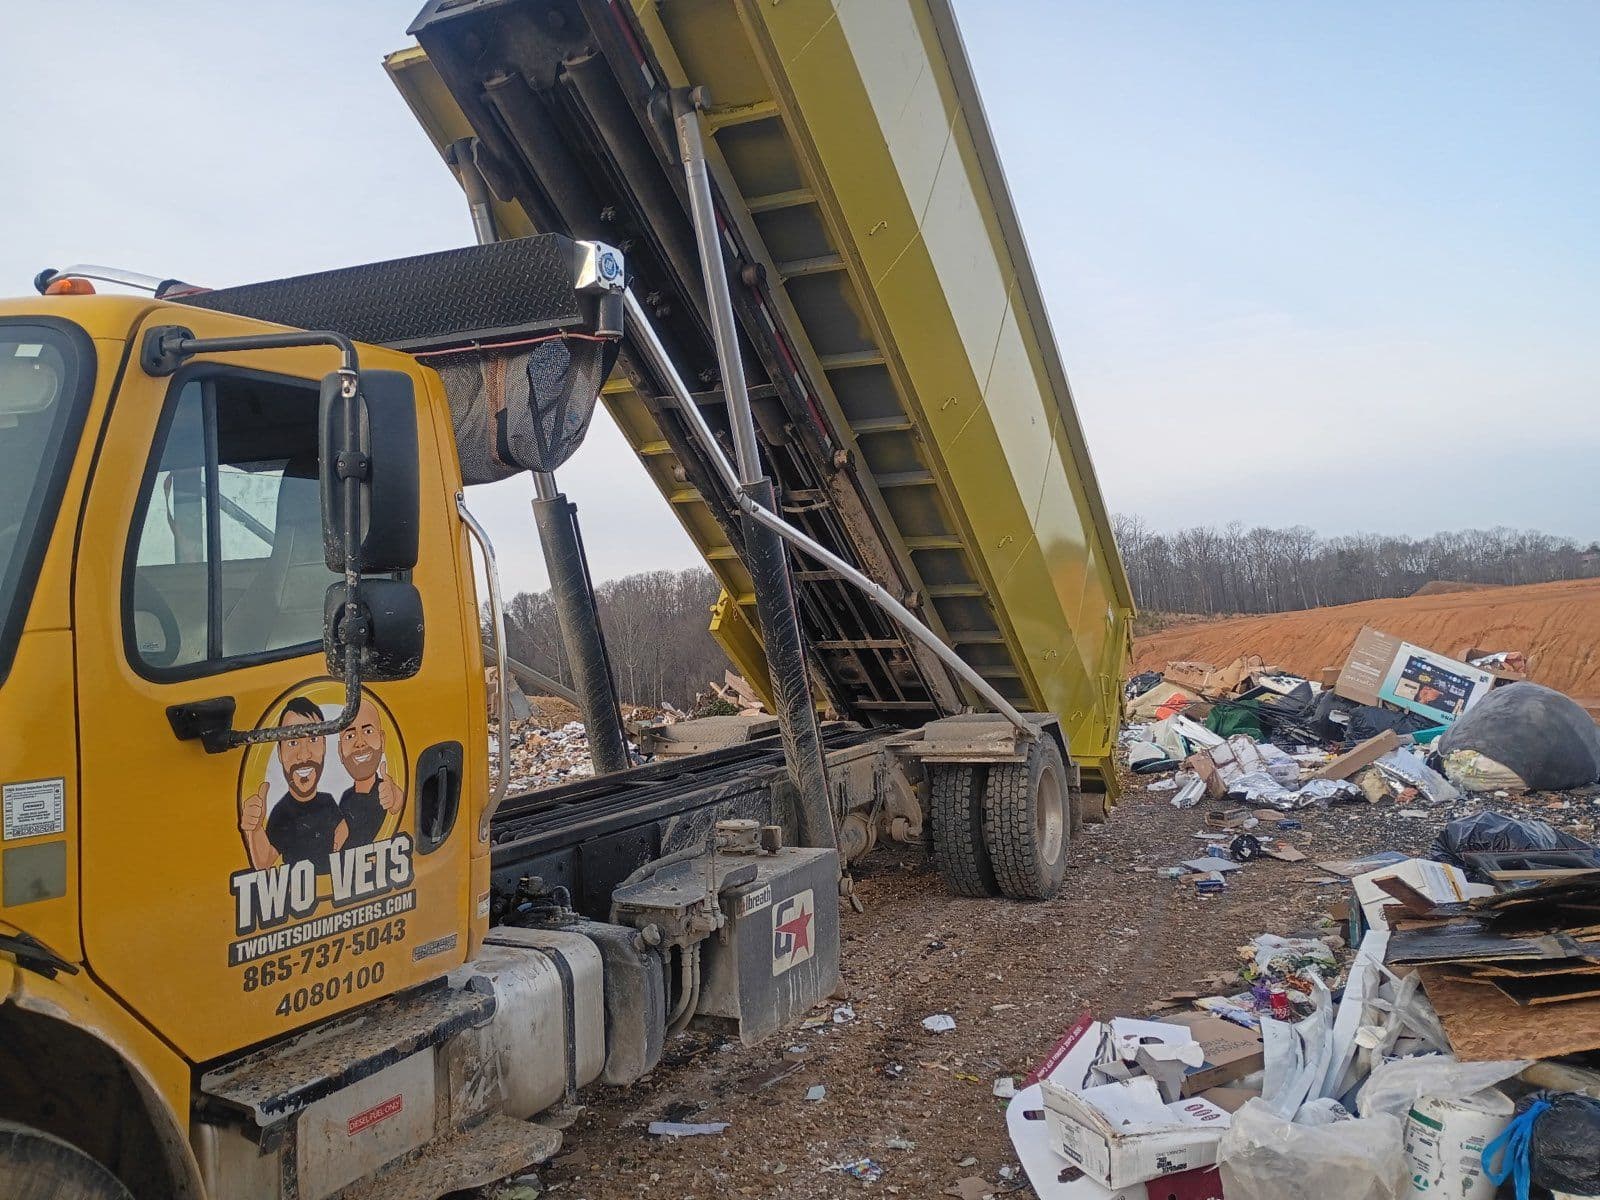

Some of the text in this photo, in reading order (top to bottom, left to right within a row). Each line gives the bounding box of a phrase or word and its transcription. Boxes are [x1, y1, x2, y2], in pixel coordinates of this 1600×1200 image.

[233, 836, 411, 929] TWO VETS
[236, 892, 413, 963] TWOVETSDUMPSTERS.COM
[243, 918, 406, 992] 865-737-5043
[275, 961, 385, 1016] 4080100
[384, 1101, 399, 1113] ONLY
